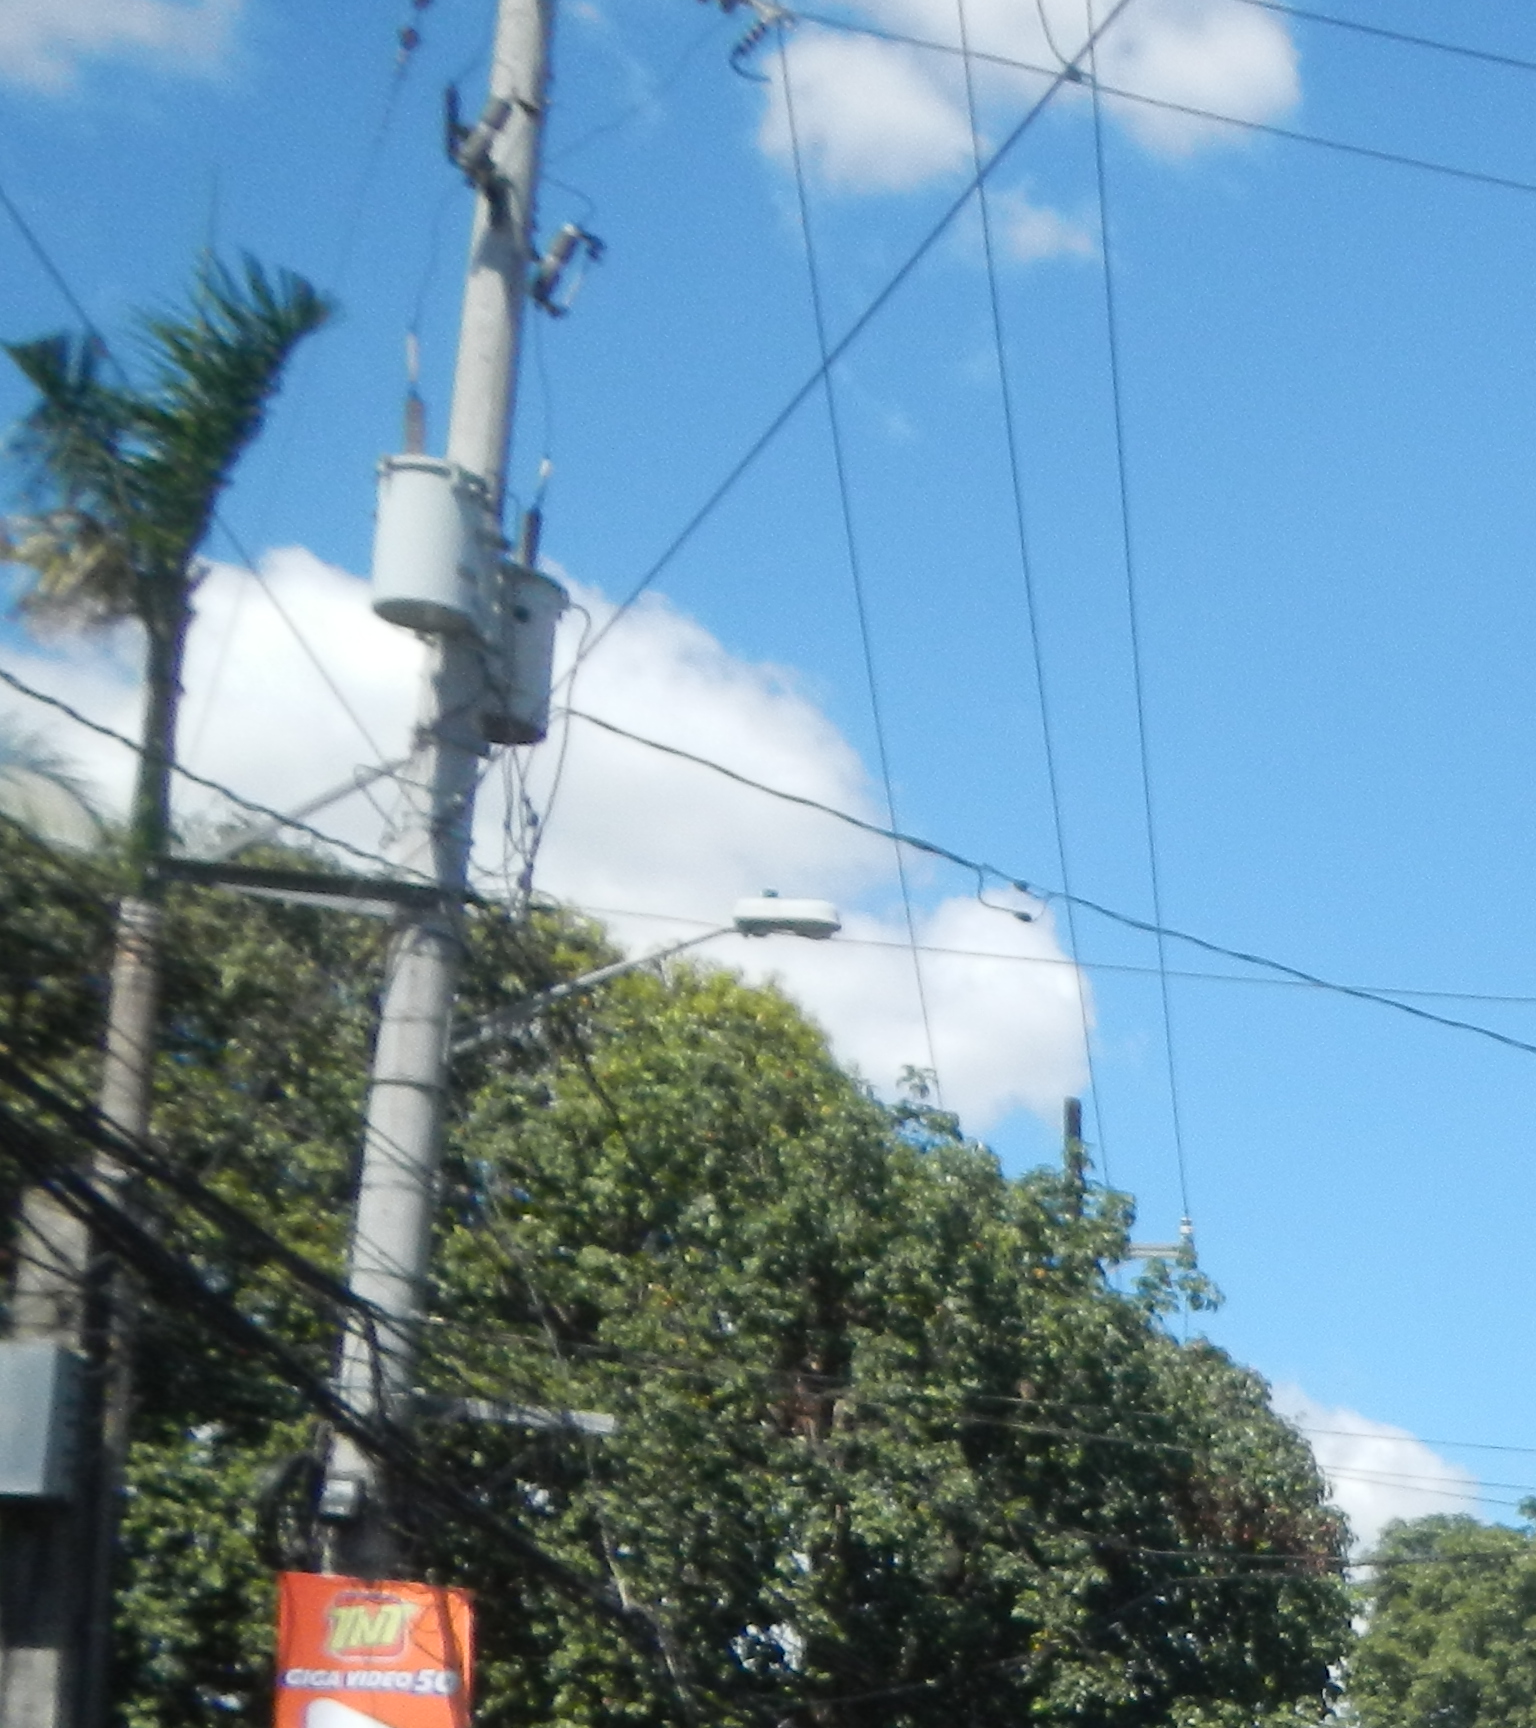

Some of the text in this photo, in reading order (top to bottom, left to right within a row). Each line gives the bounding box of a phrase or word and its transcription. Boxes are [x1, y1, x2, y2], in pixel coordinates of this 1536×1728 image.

[329, 1602, 418, 1652] TNT
[285, 1668, 340, 1689] GIGA
[345, 1669, 412, 1689] VIDEO
